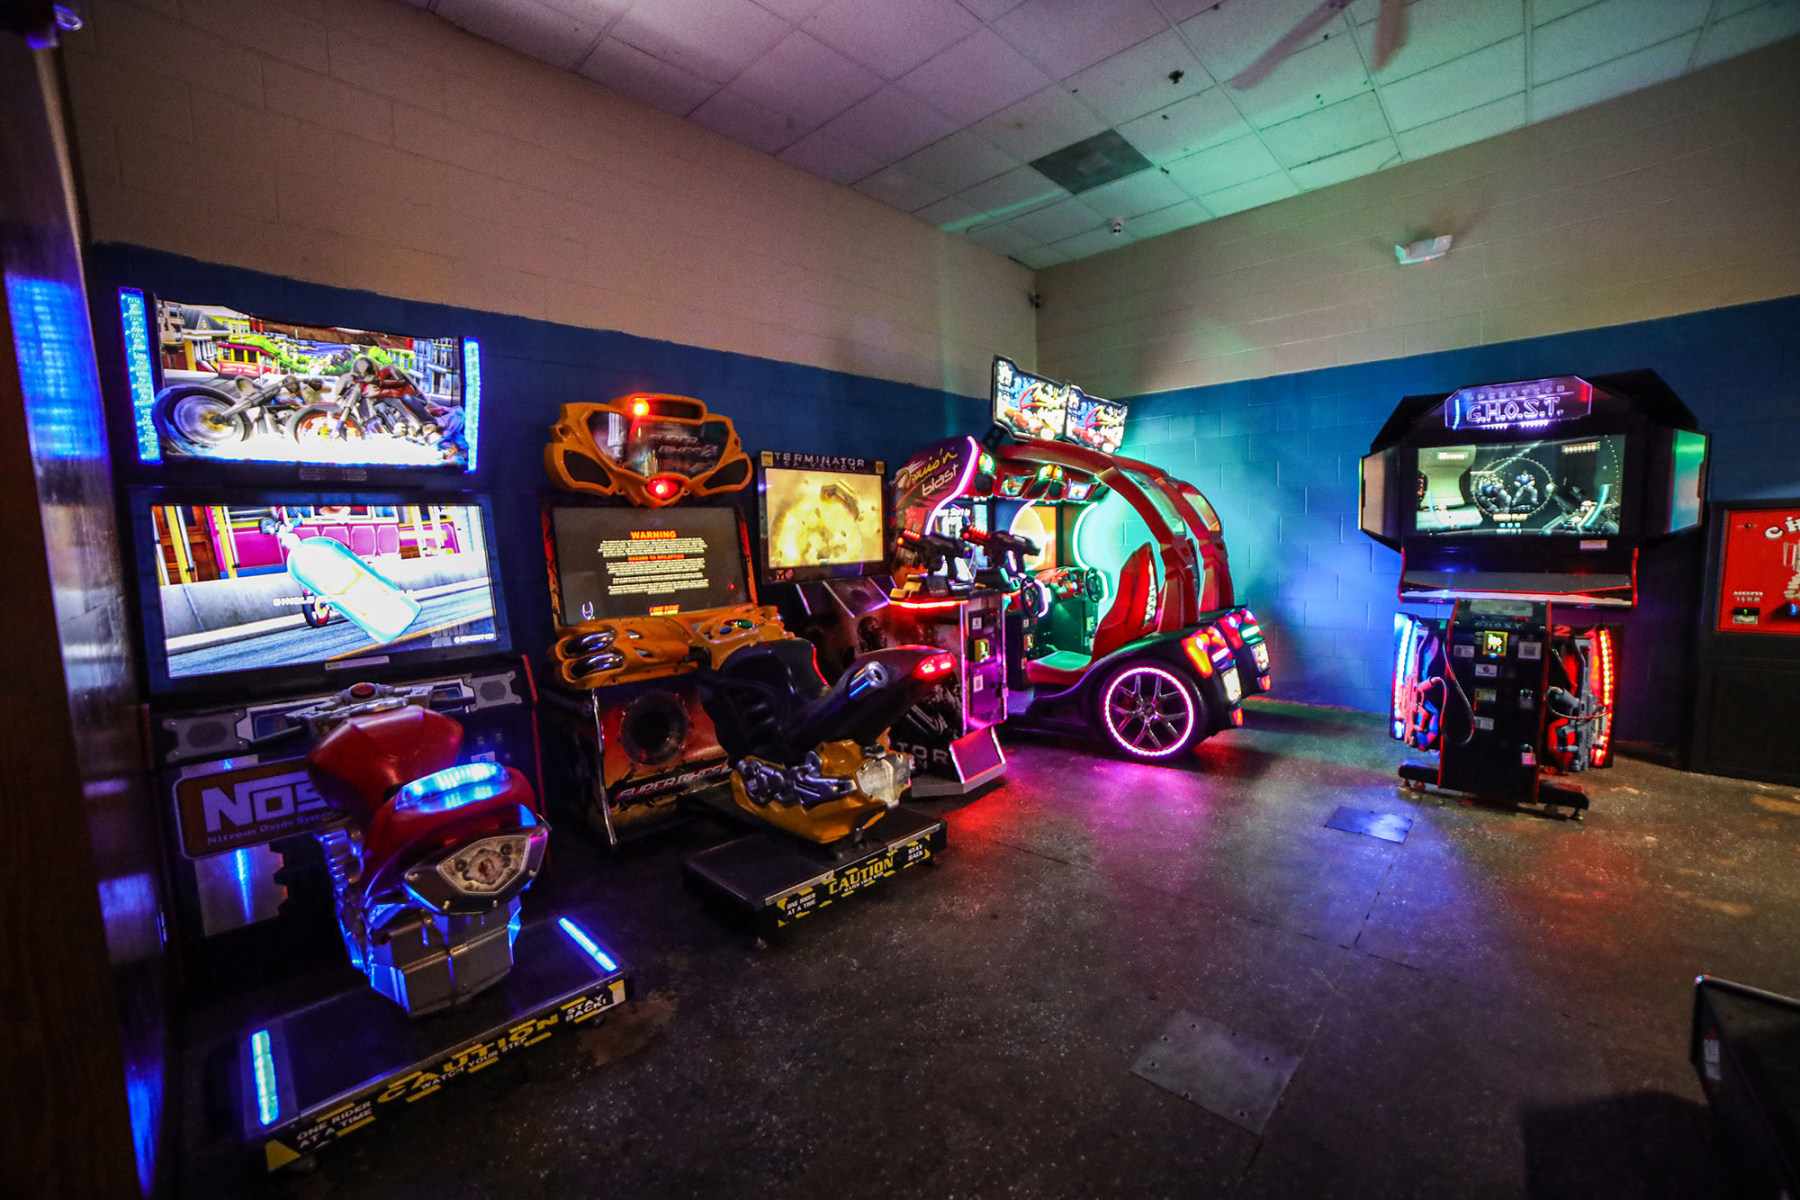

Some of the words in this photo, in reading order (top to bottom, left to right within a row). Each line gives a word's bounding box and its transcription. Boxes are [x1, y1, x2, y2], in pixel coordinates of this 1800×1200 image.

[774, 452, 865, 467] TERMINATOR
[922, 463, 959, 496] blast
[629, 530, 677, 540] WARNING
[1554, 625, 1572, 637] 2
[202, 771, 329, 833] NOS
[207, 827, 256, 845] Nitrous
[259, 820, 295, 833] Oxide
[828, 856, 894, 895] CAUTION
[786, 899, 799, 910] ONE
[787, 907, 796, 916] AT
[565, 998, 607, 1022] BACK!
[566, 993, 604, 1015] STAY
[377, 1014, 558, 1104] CAUTION
[420, 1066, 465, 1089] WATCH
[467, 1050, 498, 1067] YOUR
[501, 1037, 527, 1052] STEP
[297, 1122, 328, 1141] ONE
[331, 1100, 373, 1124] RIDER
[299, 1135, 318, 1148] AT
[325, 1127, 336, 1136] A
[340, 1108, 373, 1127] TIME
